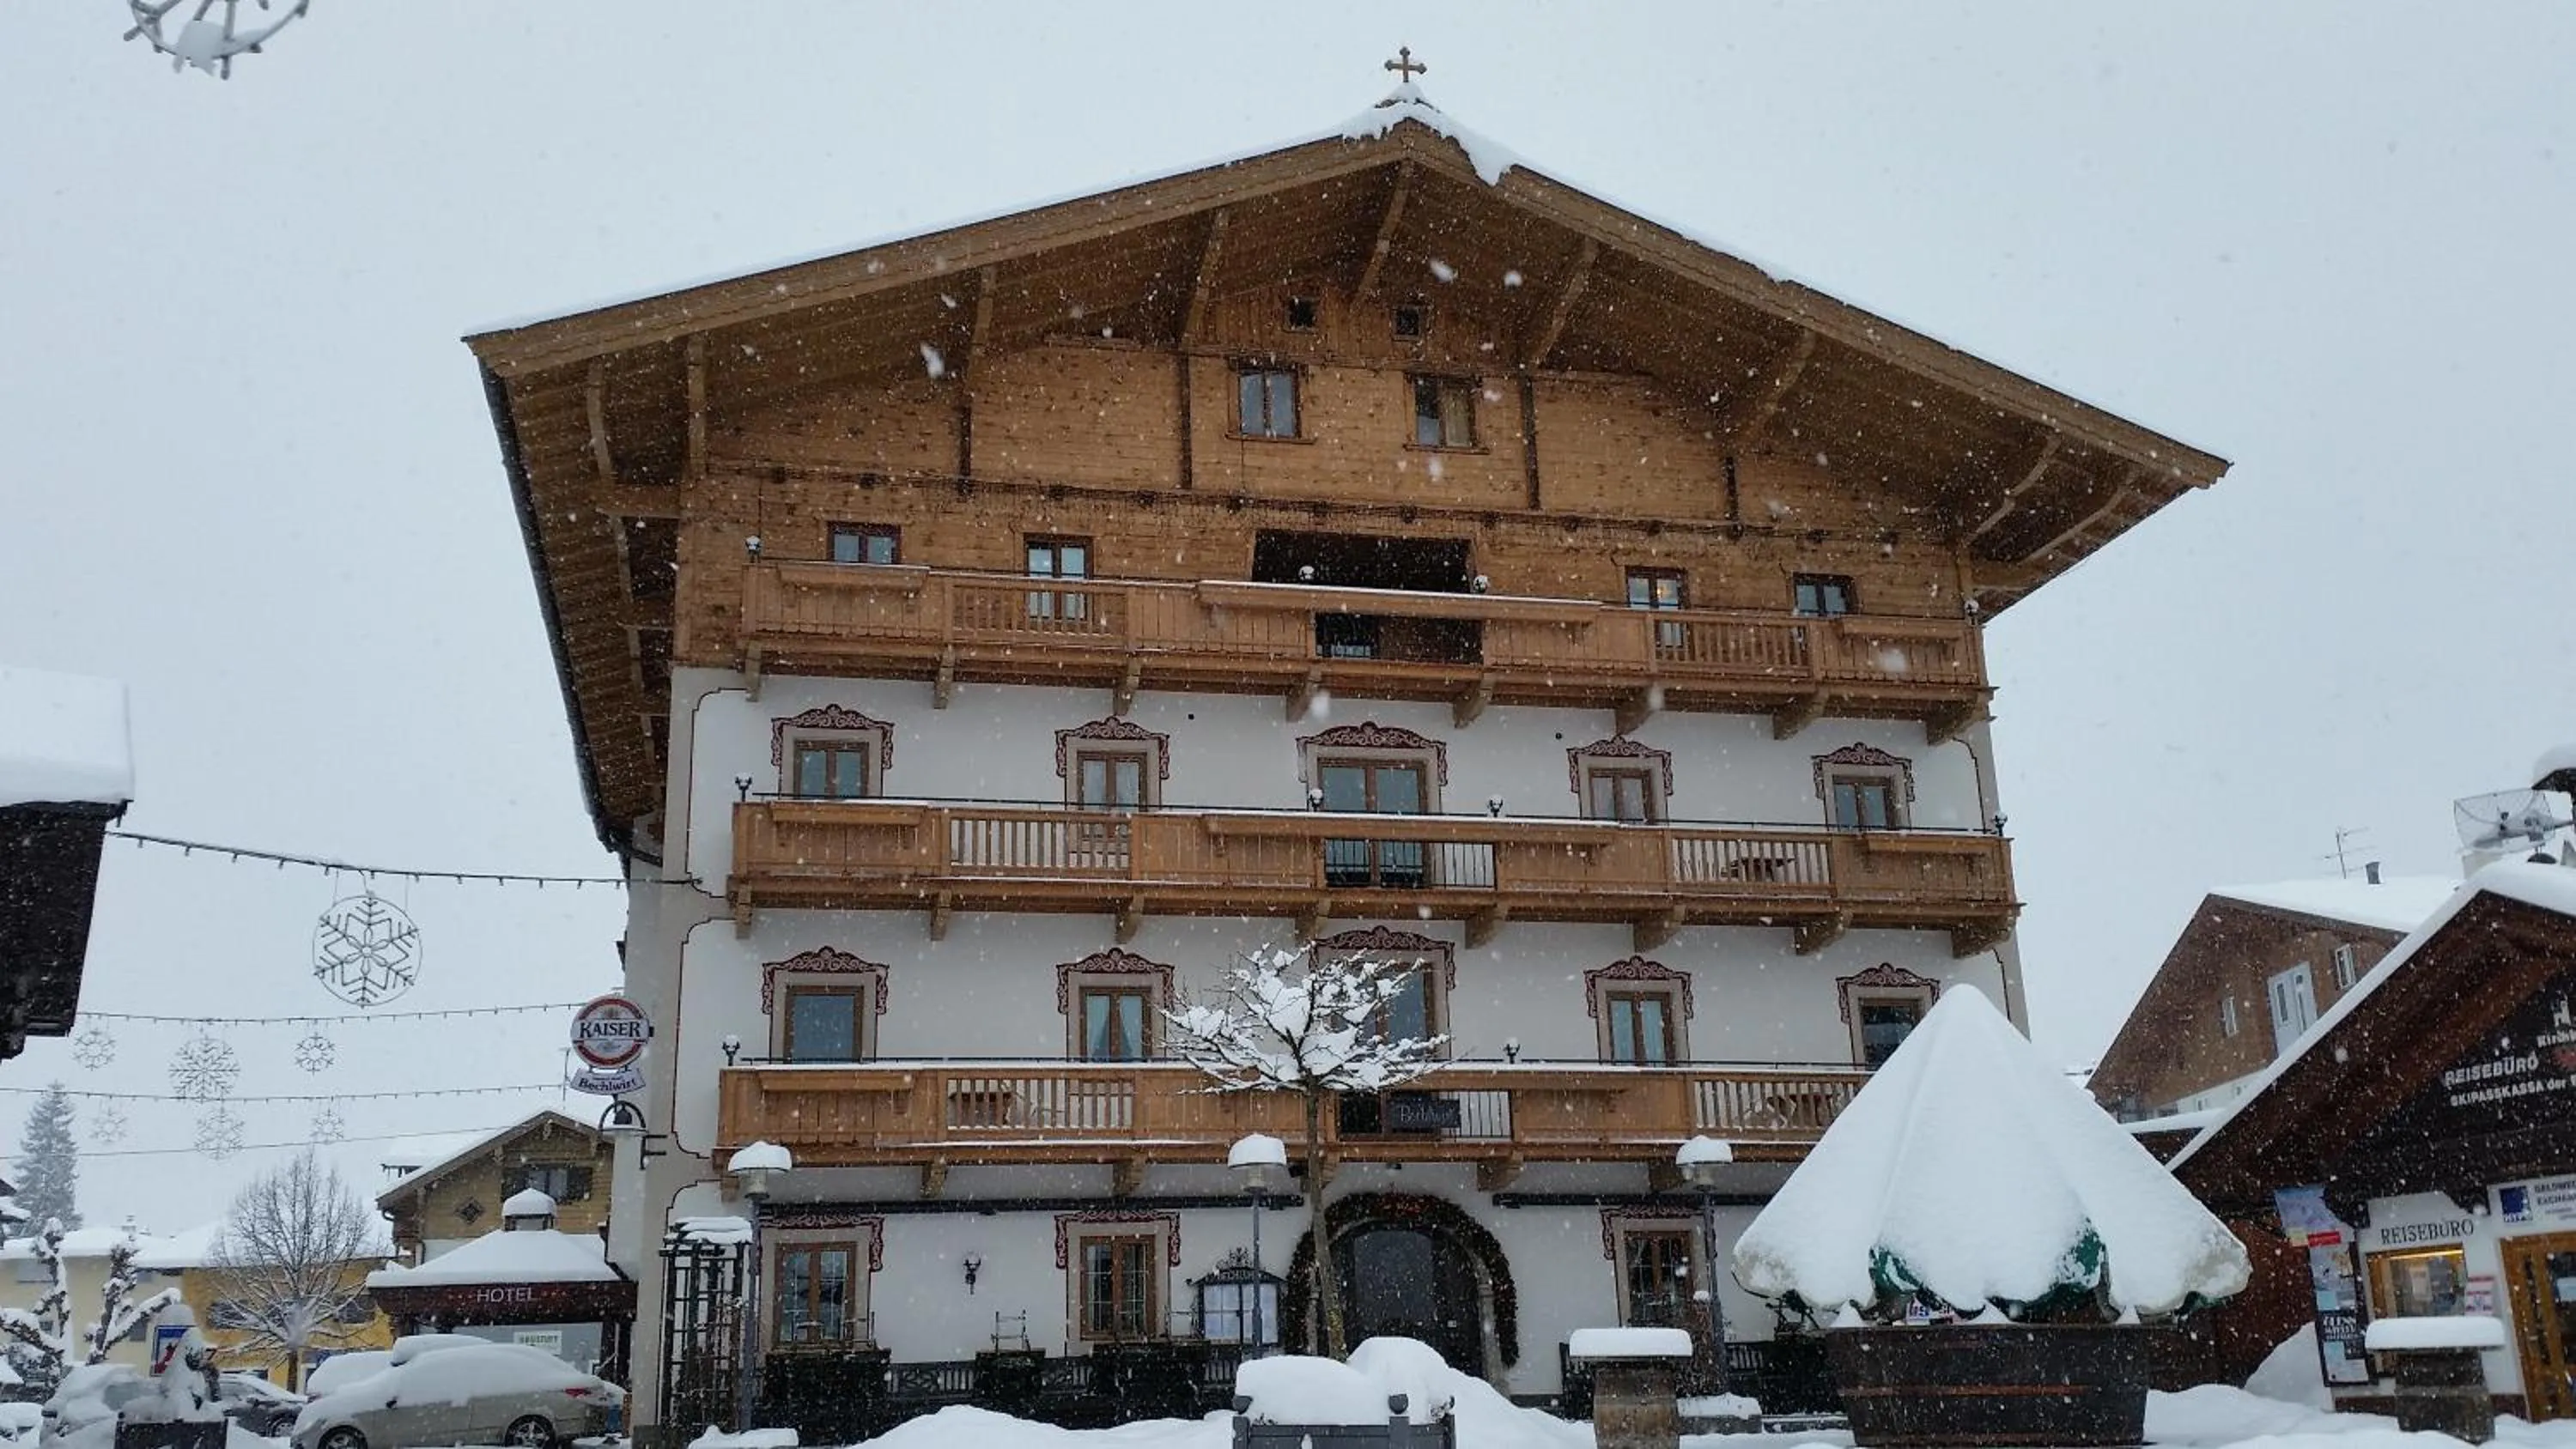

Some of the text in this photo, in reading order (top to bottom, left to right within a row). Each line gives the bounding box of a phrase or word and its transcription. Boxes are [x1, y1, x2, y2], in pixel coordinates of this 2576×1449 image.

[579, 1021, 641, 1039] KAISER
[2450, 1081, 2544, 1106] SKIPASSKASSA
[2546, 1078, 2567, 1091] der
[477, 1287, 539, 1303] HOTEL
